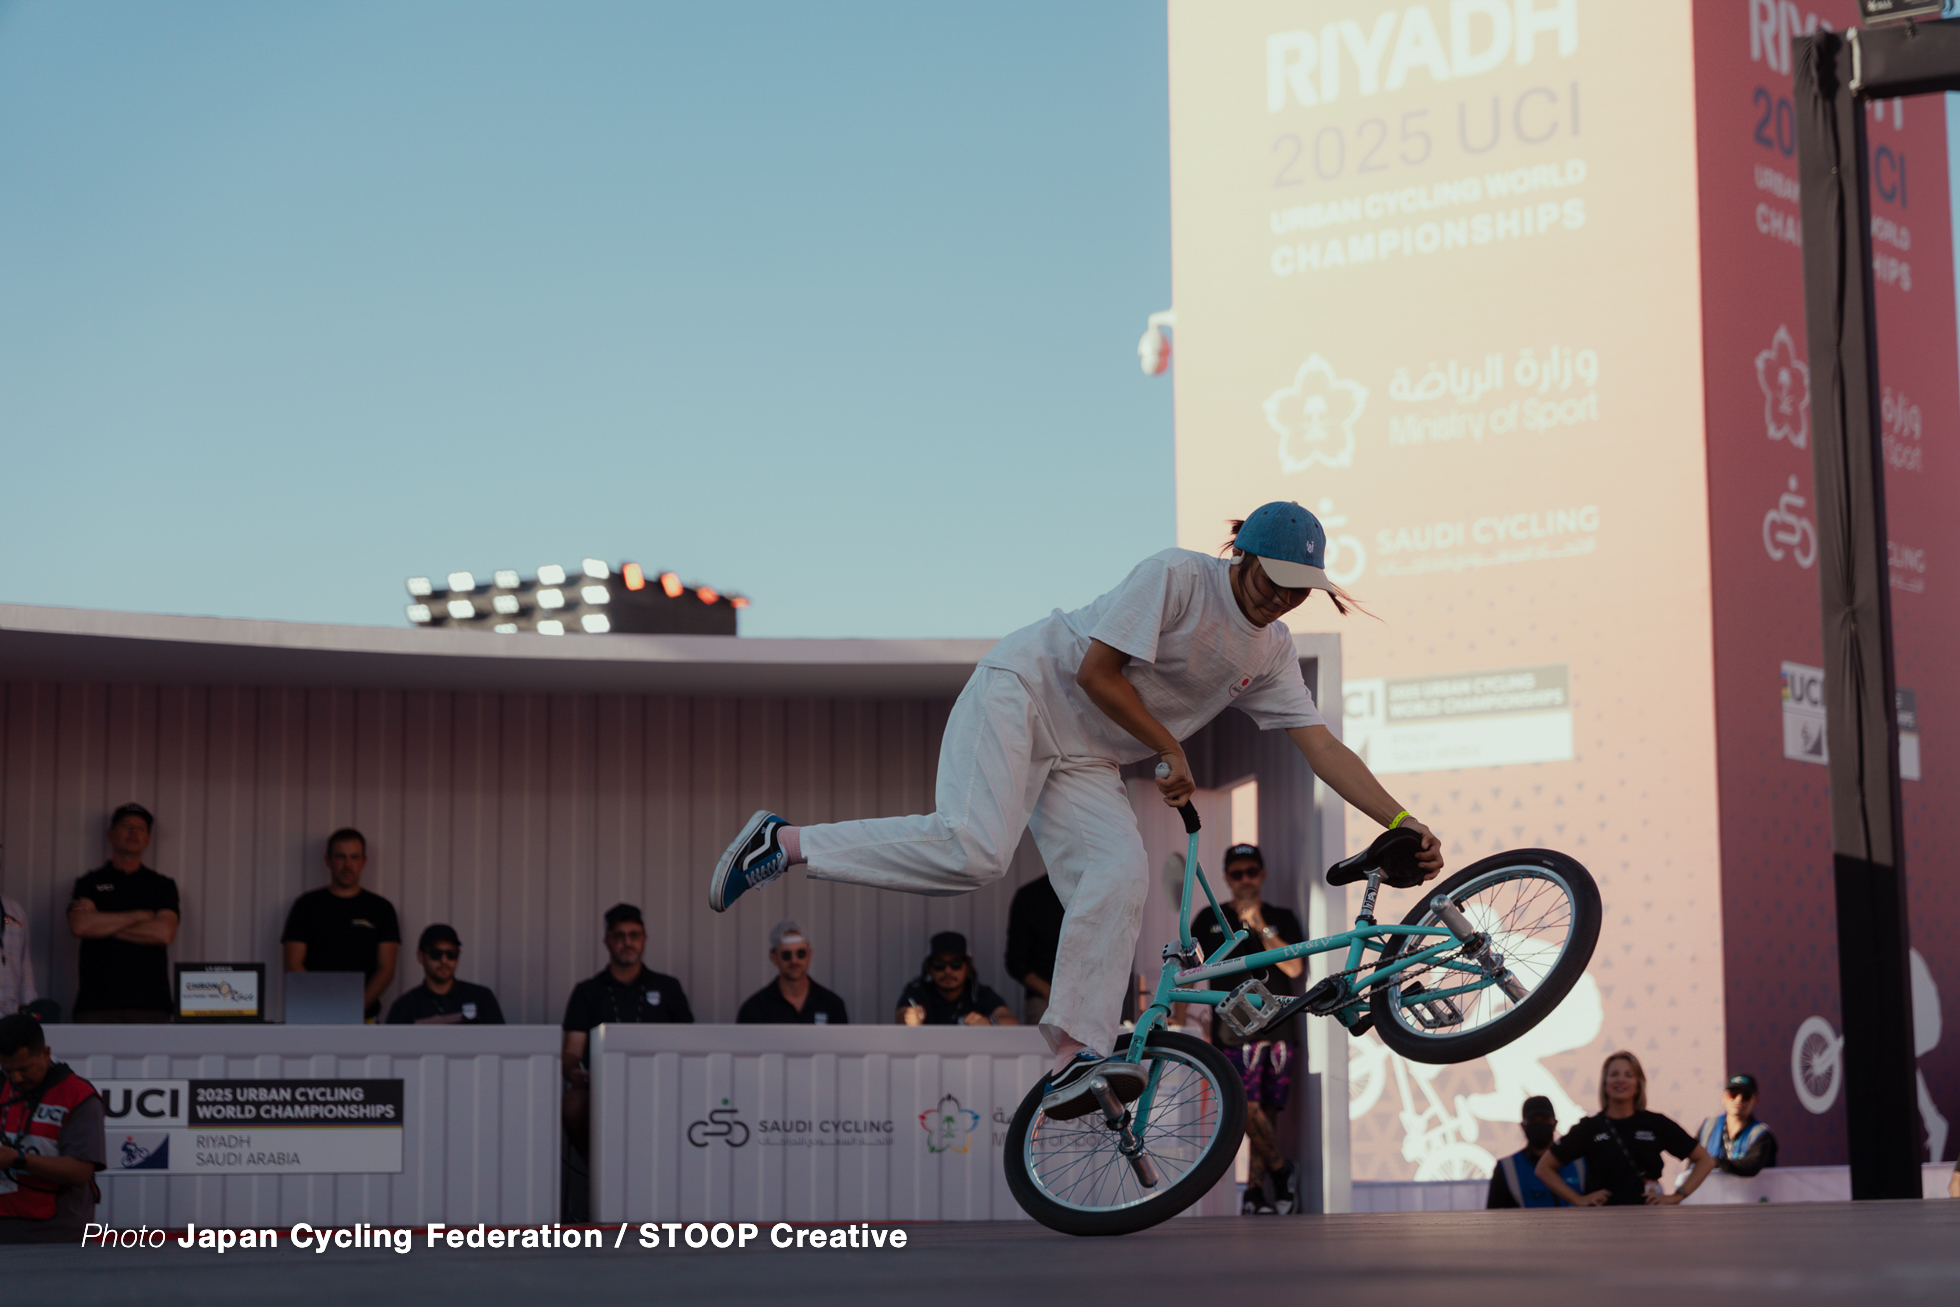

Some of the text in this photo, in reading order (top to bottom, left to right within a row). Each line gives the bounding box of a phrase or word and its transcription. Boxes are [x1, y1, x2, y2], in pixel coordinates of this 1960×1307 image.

[1265, 0, 1579, 114] RIYADH
[1271, 79, 1582, 190] 2025 UCI
[1269, 158, 1587, 236] URBAN CYCLING WORLD
[1873, 145, 1907, 210] CI
[1269, 196, 1587, 277] CHAMPIONSHIPS
[1388, 342, 1598, 405] وزارة الرياضة
[1388, 388, 1600, 448] Ministry of Sport
[1375, 504, 1600, 556] SAUDI CYCLING
[1342, 688, 1376, 719] CI
[102, 1088, 180, 1118] UCI
[196, 1087, 365, 1103] 2025 URBAN CYCLING
[196, 1104, 396, 1119] WORLD CHAMPIONSHIPS
[196, 1134, 251, 1149] RIYADH
[758, 1120, 894, 1134] SAUDI CYCLING
[196, 1152, 301, 1166] SAUDI ARABIA
